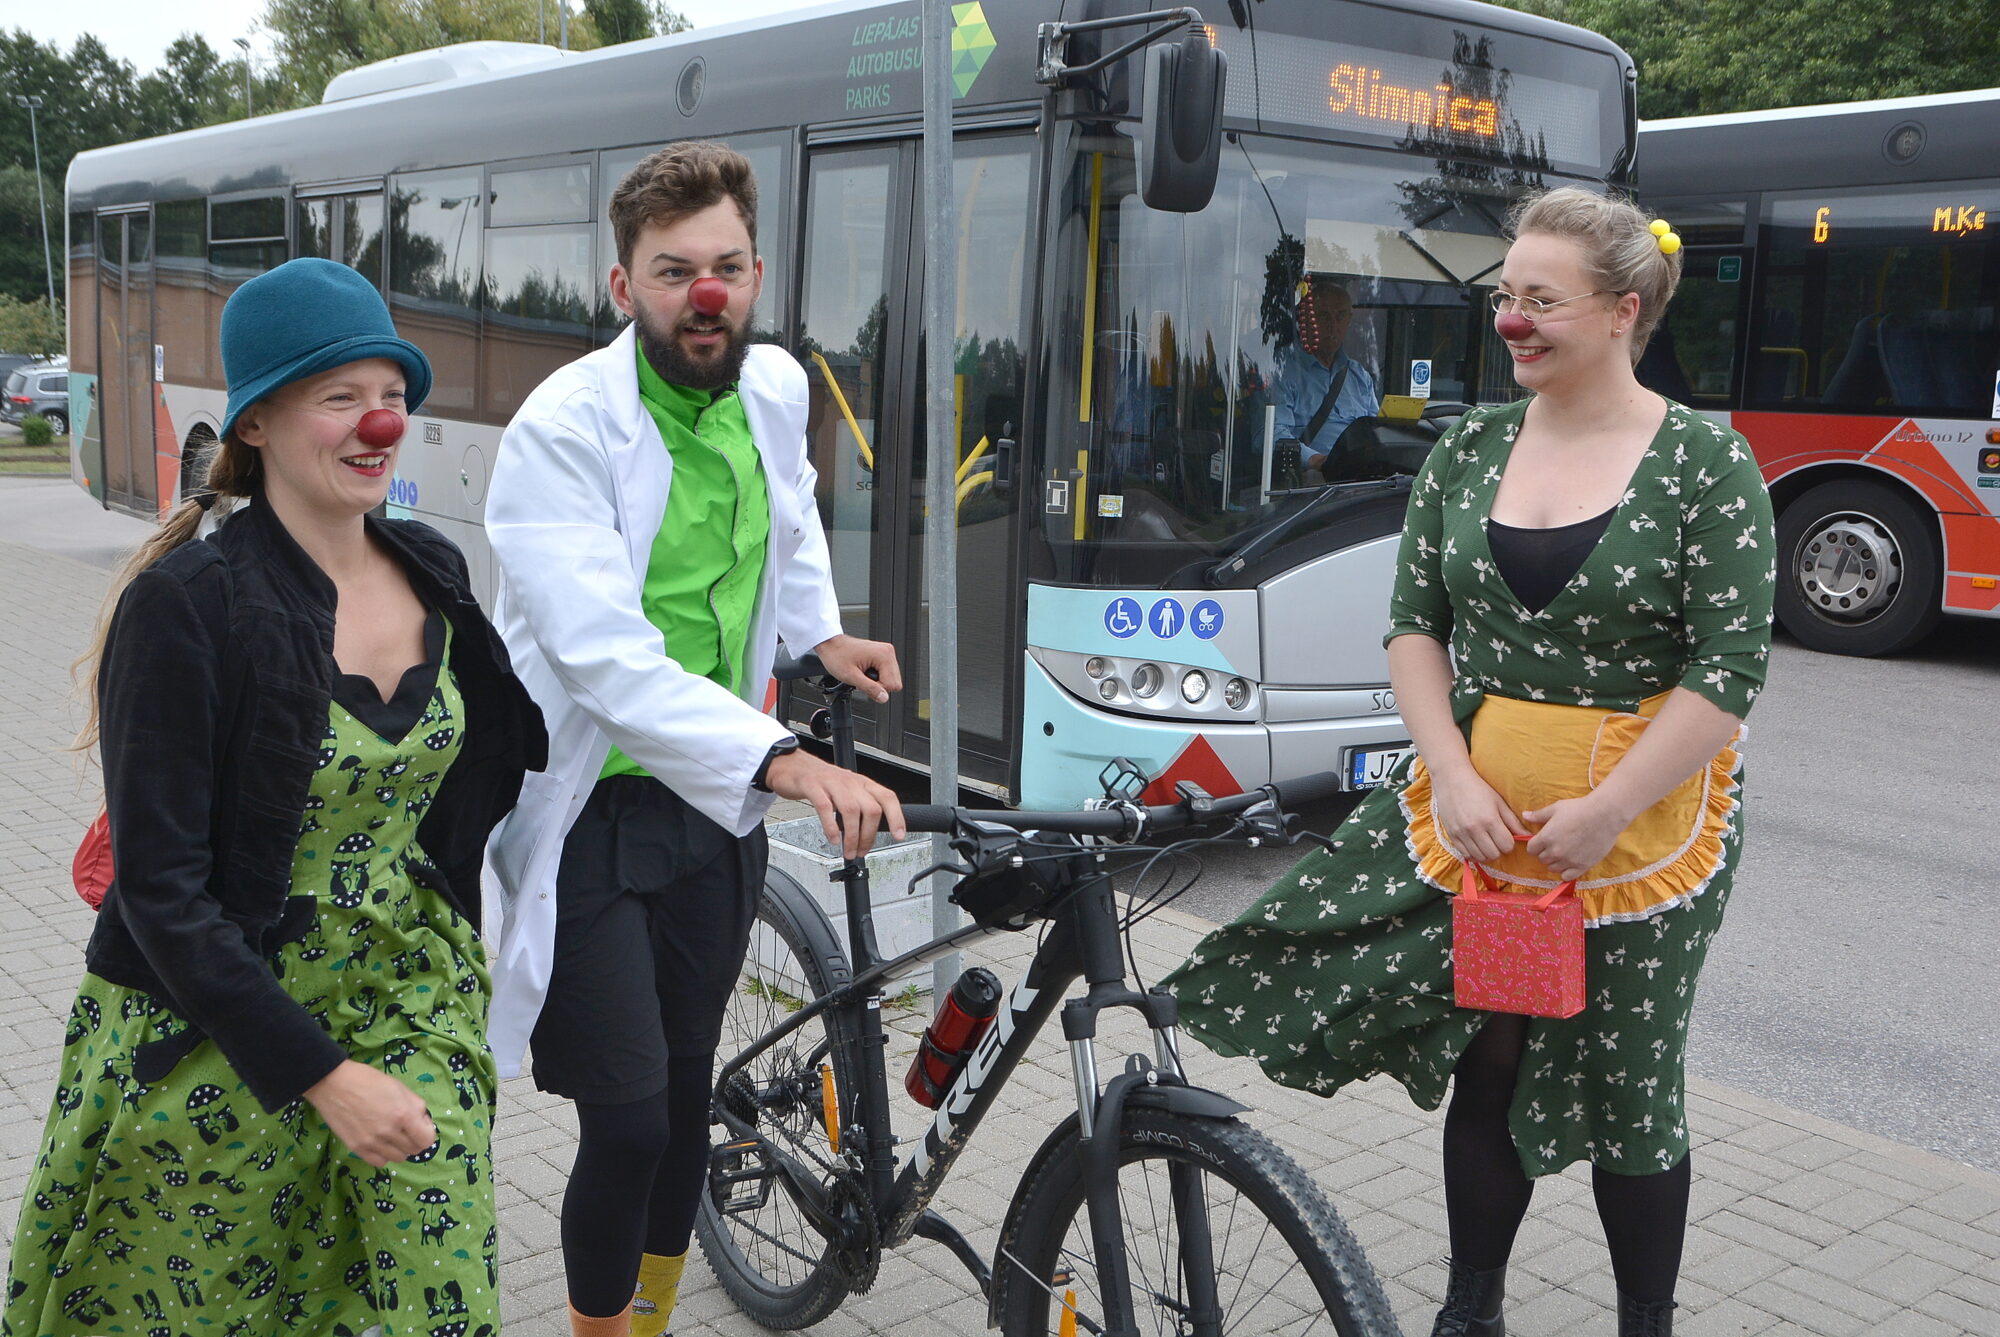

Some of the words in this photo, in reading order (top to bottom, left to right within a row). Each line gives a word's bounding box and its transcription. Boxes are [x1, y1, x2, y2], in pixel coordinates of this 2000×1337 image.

[851, 15, 921, 47] LIEPĀJAS
[846, 47, 924, 79] AUTOBUSU
[846, 84, 891, 111] PARKS
[1329, 63, 1497, 136] Slimnīca
[1814, 205, 1831, 244] 6
[1895, 429, 1953, 444] Urbino
[1956, 431, 1974, 444] 12
[1354, 771, 1364, 780] LV
[903, 963, 1041, 1178] TREK
[1132, 1129, 1185, 1149] COMP
